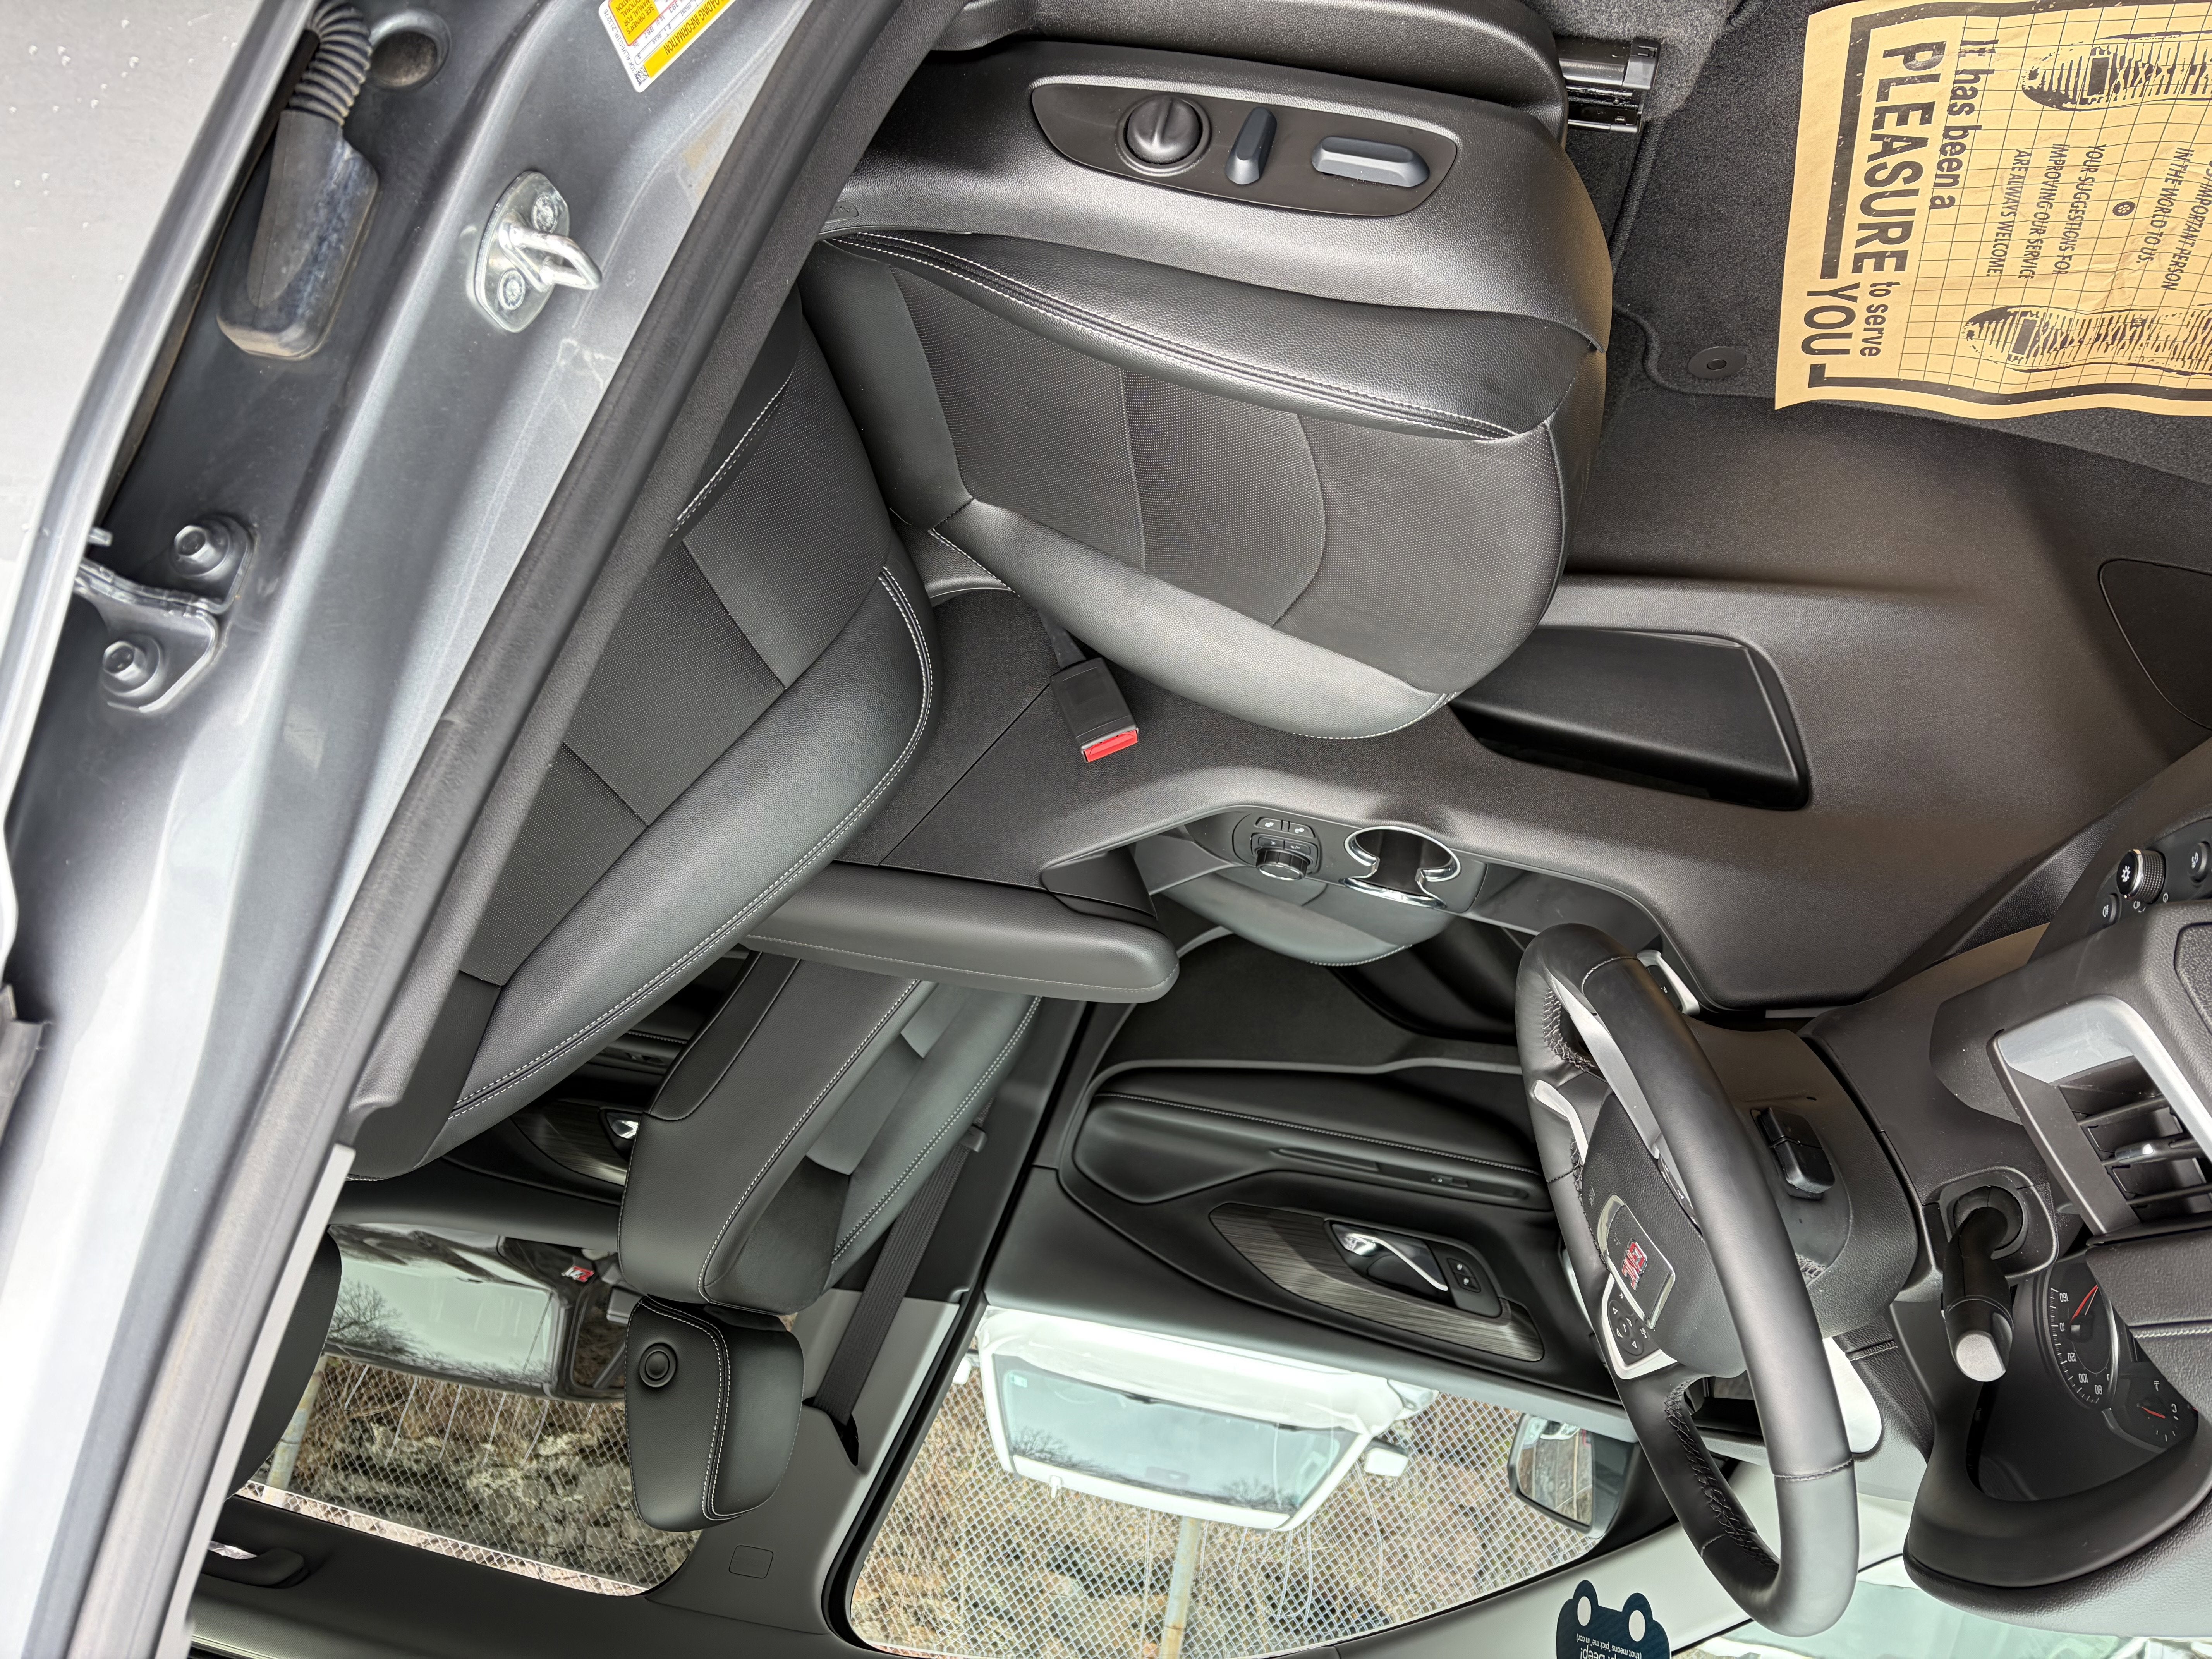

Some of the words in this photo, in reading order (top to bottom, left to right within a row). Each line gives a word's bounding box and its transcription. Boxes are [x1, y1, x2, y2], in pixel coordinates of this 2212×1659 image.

[632, 0, 650, 17] MANUAL
[644, 4, 654, 16] SEE
[669, 2, 679, 13] 393
[698, 0, 723, 21] OADING
[623, 14, 633, 27] FOR
[626, 12, 645, 34] OWNER'S
[644, 26, 654, 39] 867
[652, 33, 662, 44] REAR
[663, 14, 700, 56] INFORMATION
[1958, 40, 1999, 57] It
[1947, 69, 1995, 116] has
[1851, 41, 1947, 273] PLEASURE
[1933, 125, 1982, 187] been
[2011, 149, 2032, 172] ARE
[2080, 144, 2107, 173] YOUR
[2173, 147, 2195, 161] IN
[2036, 143, 2070, 209] IMPROVING
[2164, 163, 2188, 185] THE
[1929, 195, 1956, 210] a
[2001, 173, 2026, 217] ALWAYS
[2059, 176, 2095, 251] SUGGESTIONS
[2150, 188, 2179, 228] WORLD
[2178, 182, 2212, 247] IMPORTANT
[2029, 211, 2051, 235] OUR
[1986, 220, 2014, 276] WELCOME.
[2144, 231, 2164, 245] TO
[2018, 239, 2044, 279] SERVICE
[2052, 254, 2073, 275] FOR
[2136, 247, 2158, 263] US.
[2161, 247, 2192, 290] PERSON
[1869, 281, 1900, 297] to
[1801, 282, 1860, 355] YOU
[1860, 304, 1889, 357] serve
[2059, 1293, 2069, 1302] 160
[2067, 1352, 2077, 1362] 120
[2078, 1373, 2088, 1383] 100
[1585, 1637, 1590, 1645] in
[1612, 1645, 1628, 1656] means
